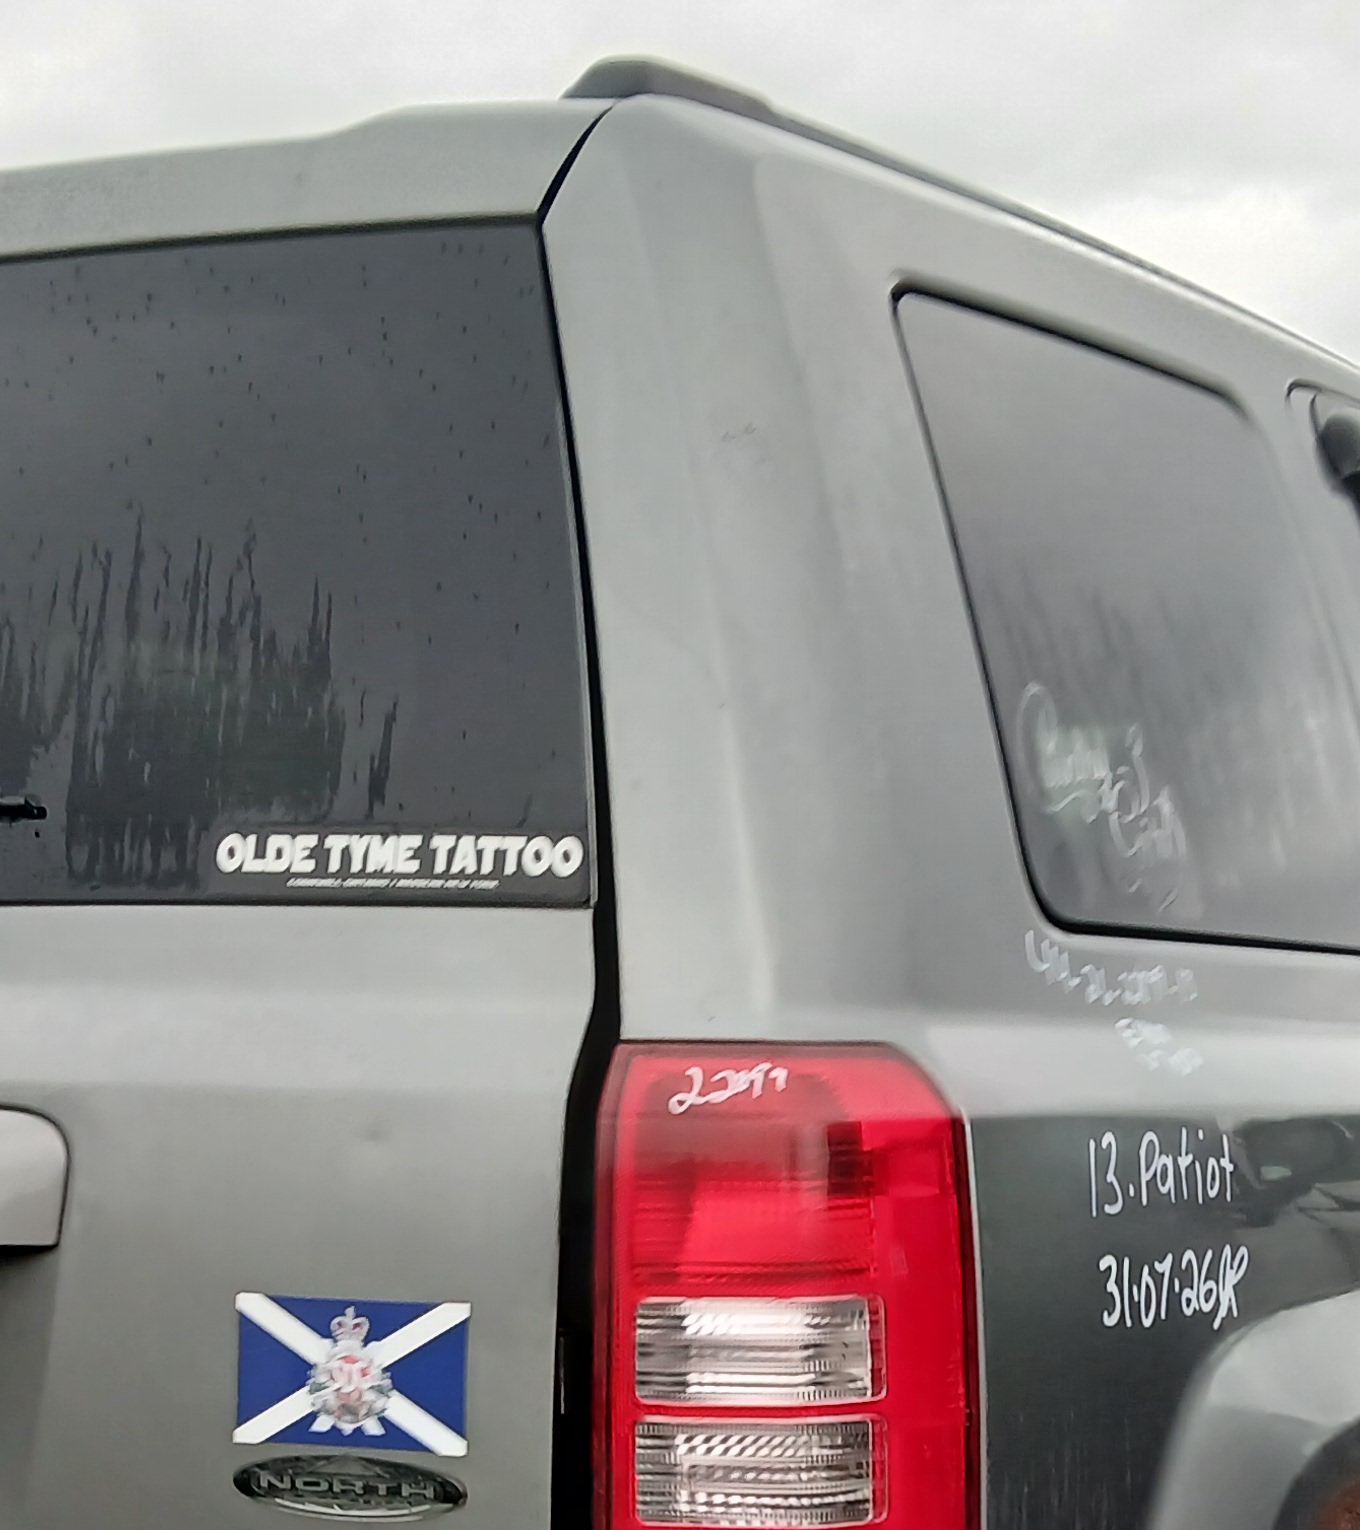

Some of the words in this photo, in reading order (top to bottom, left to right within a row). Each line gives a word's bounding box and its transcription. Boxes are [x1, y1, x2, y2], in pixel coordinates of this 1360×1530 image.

[216, 833, 318, 874] OLDE
[324, 834, 423, 875] TYME
[429, 834, 584, 878] TATTOO
[259, 1471, 436, 1500] NORTH
